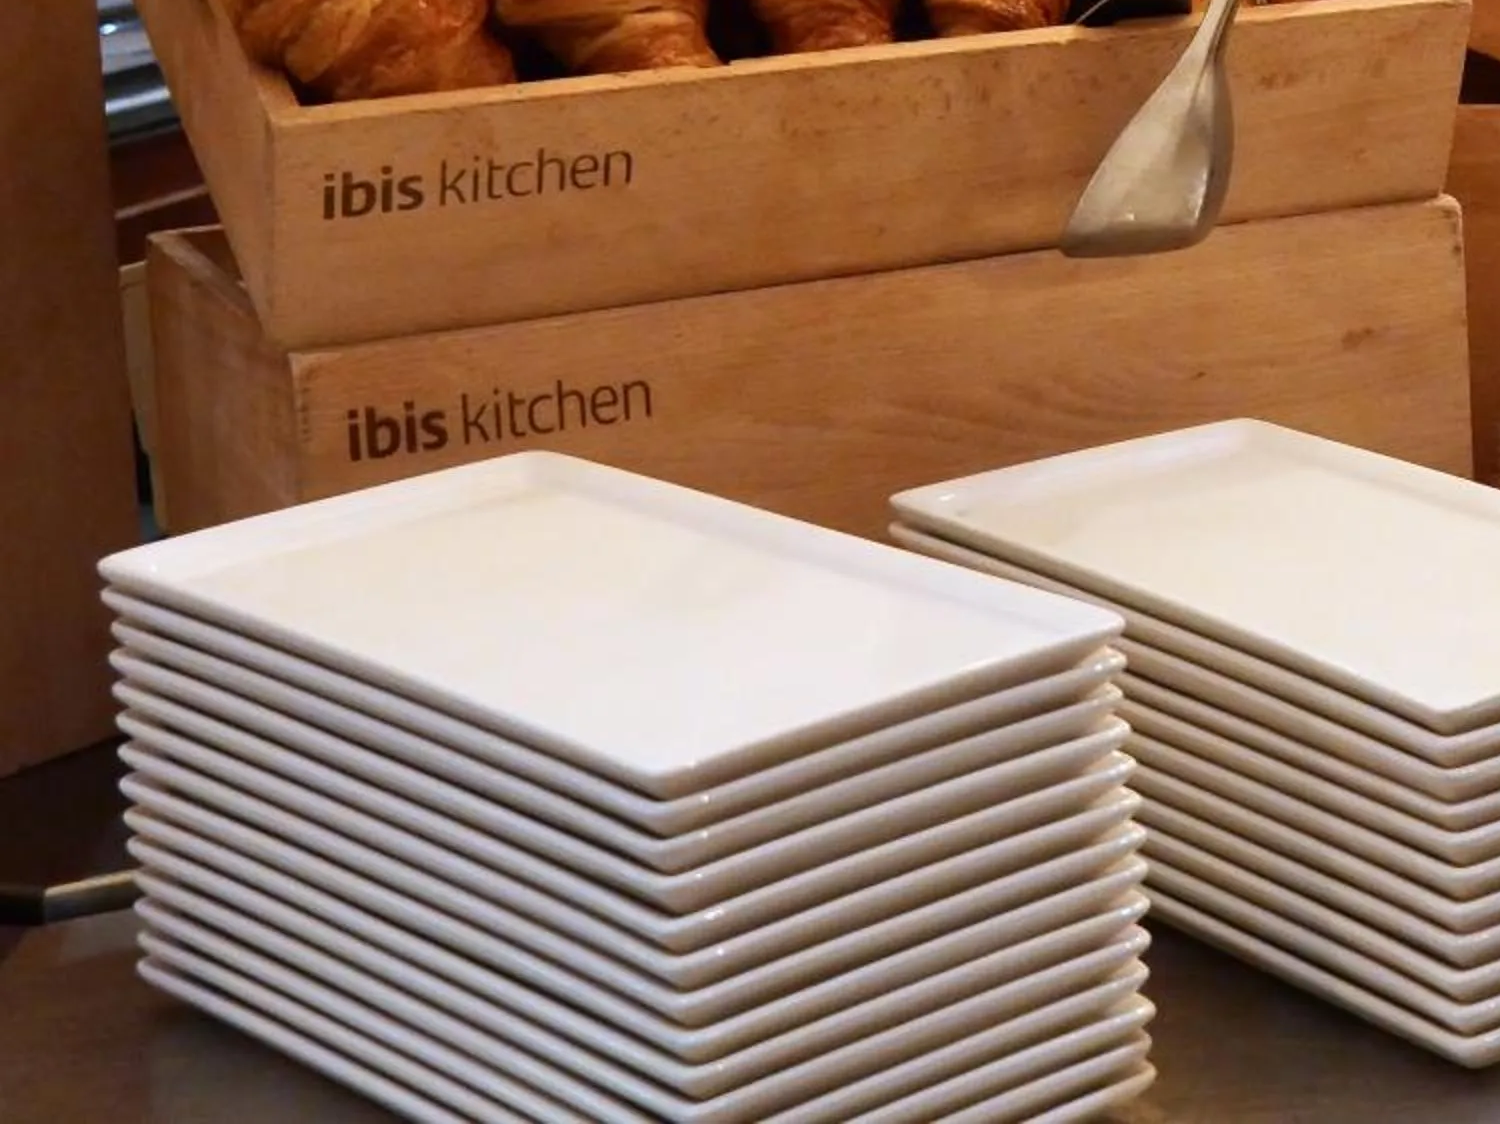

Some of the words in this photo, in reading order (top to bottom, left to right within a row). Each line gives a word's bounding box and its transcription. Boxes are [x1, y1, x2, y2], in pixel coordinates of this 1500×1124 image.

[322, 165, 424, 221] ibis
[439, 146, 634, 207] kitchen
[346, 400, 449, 462] ibis
[461, 378, 653, 446] kitchen
